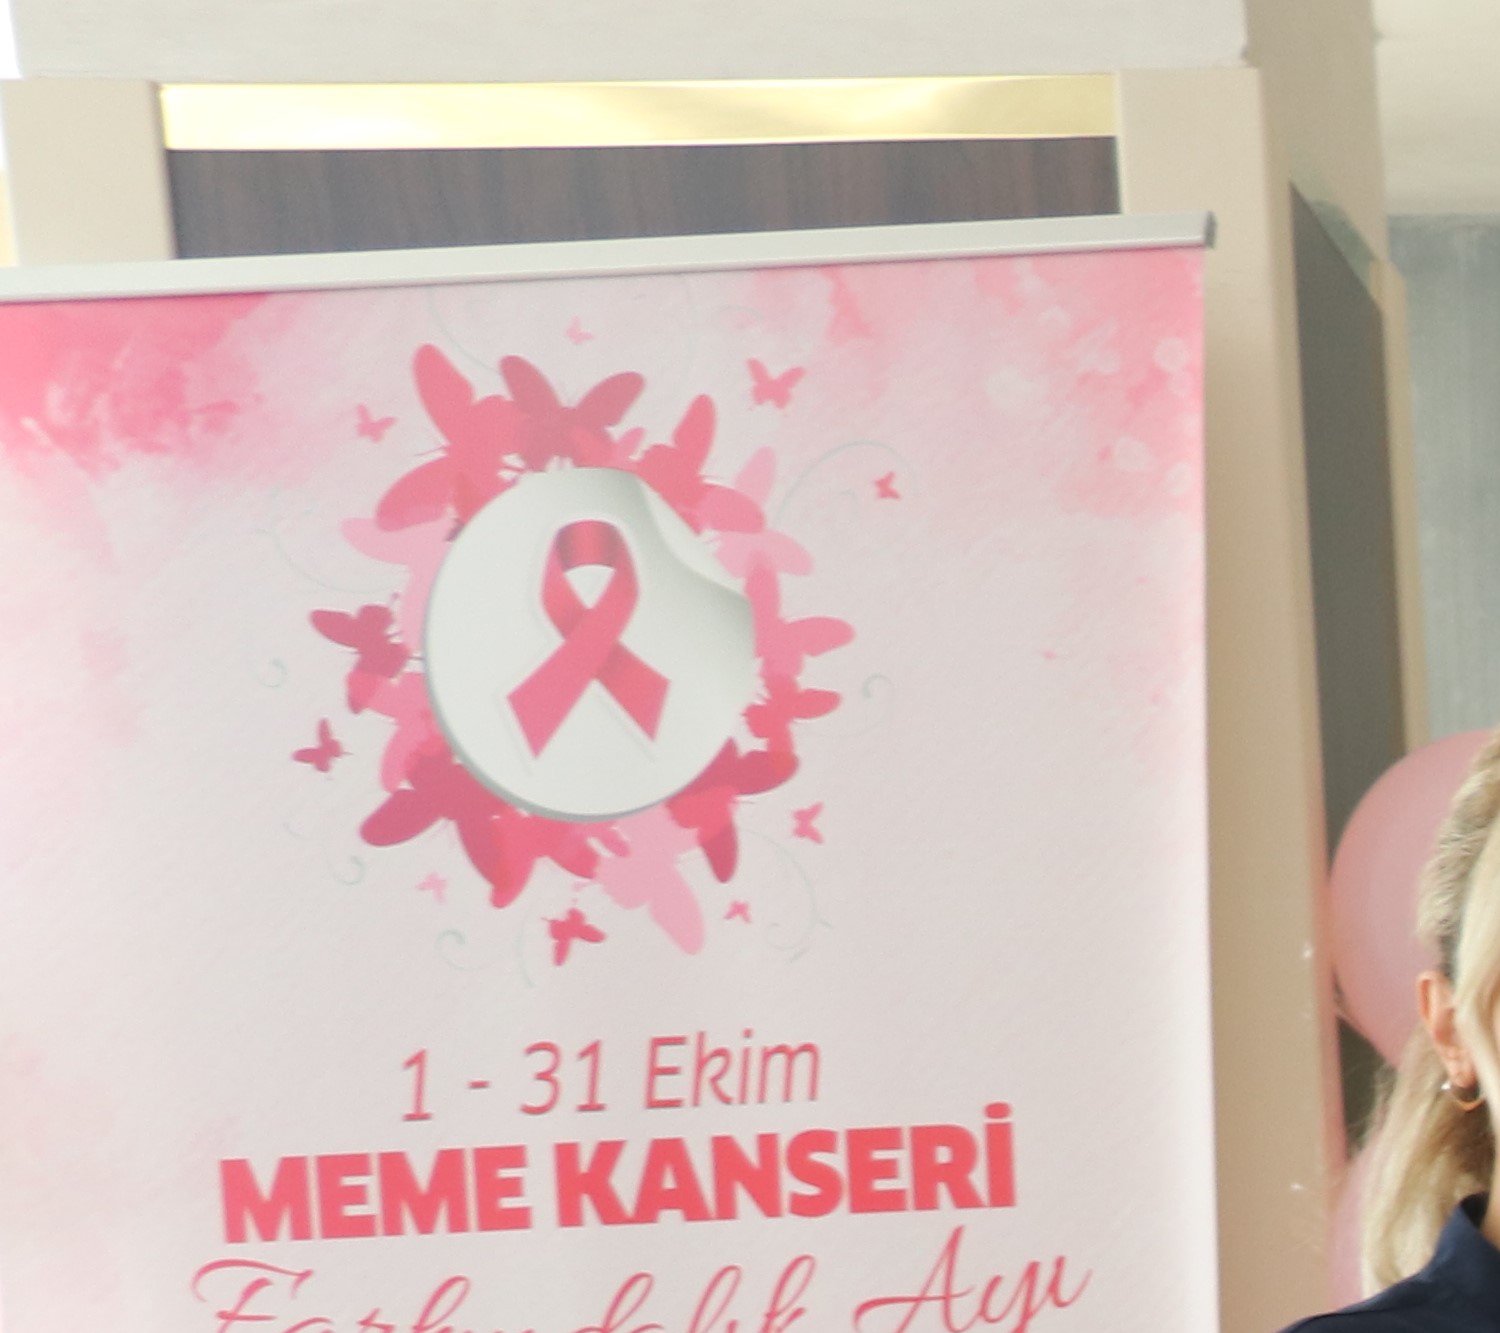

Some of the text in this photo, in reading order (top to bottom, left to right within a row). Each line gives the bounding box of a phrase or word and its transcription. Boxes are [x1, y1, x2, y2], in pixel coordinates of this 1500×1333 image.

[402, 1049, 433, 1123] 1
[519, 1039, 607, 1116] 31
[643, 1028, 820, 1110] Ekim
[220, 1102, 1017, 1244] MEME KANSERİ
